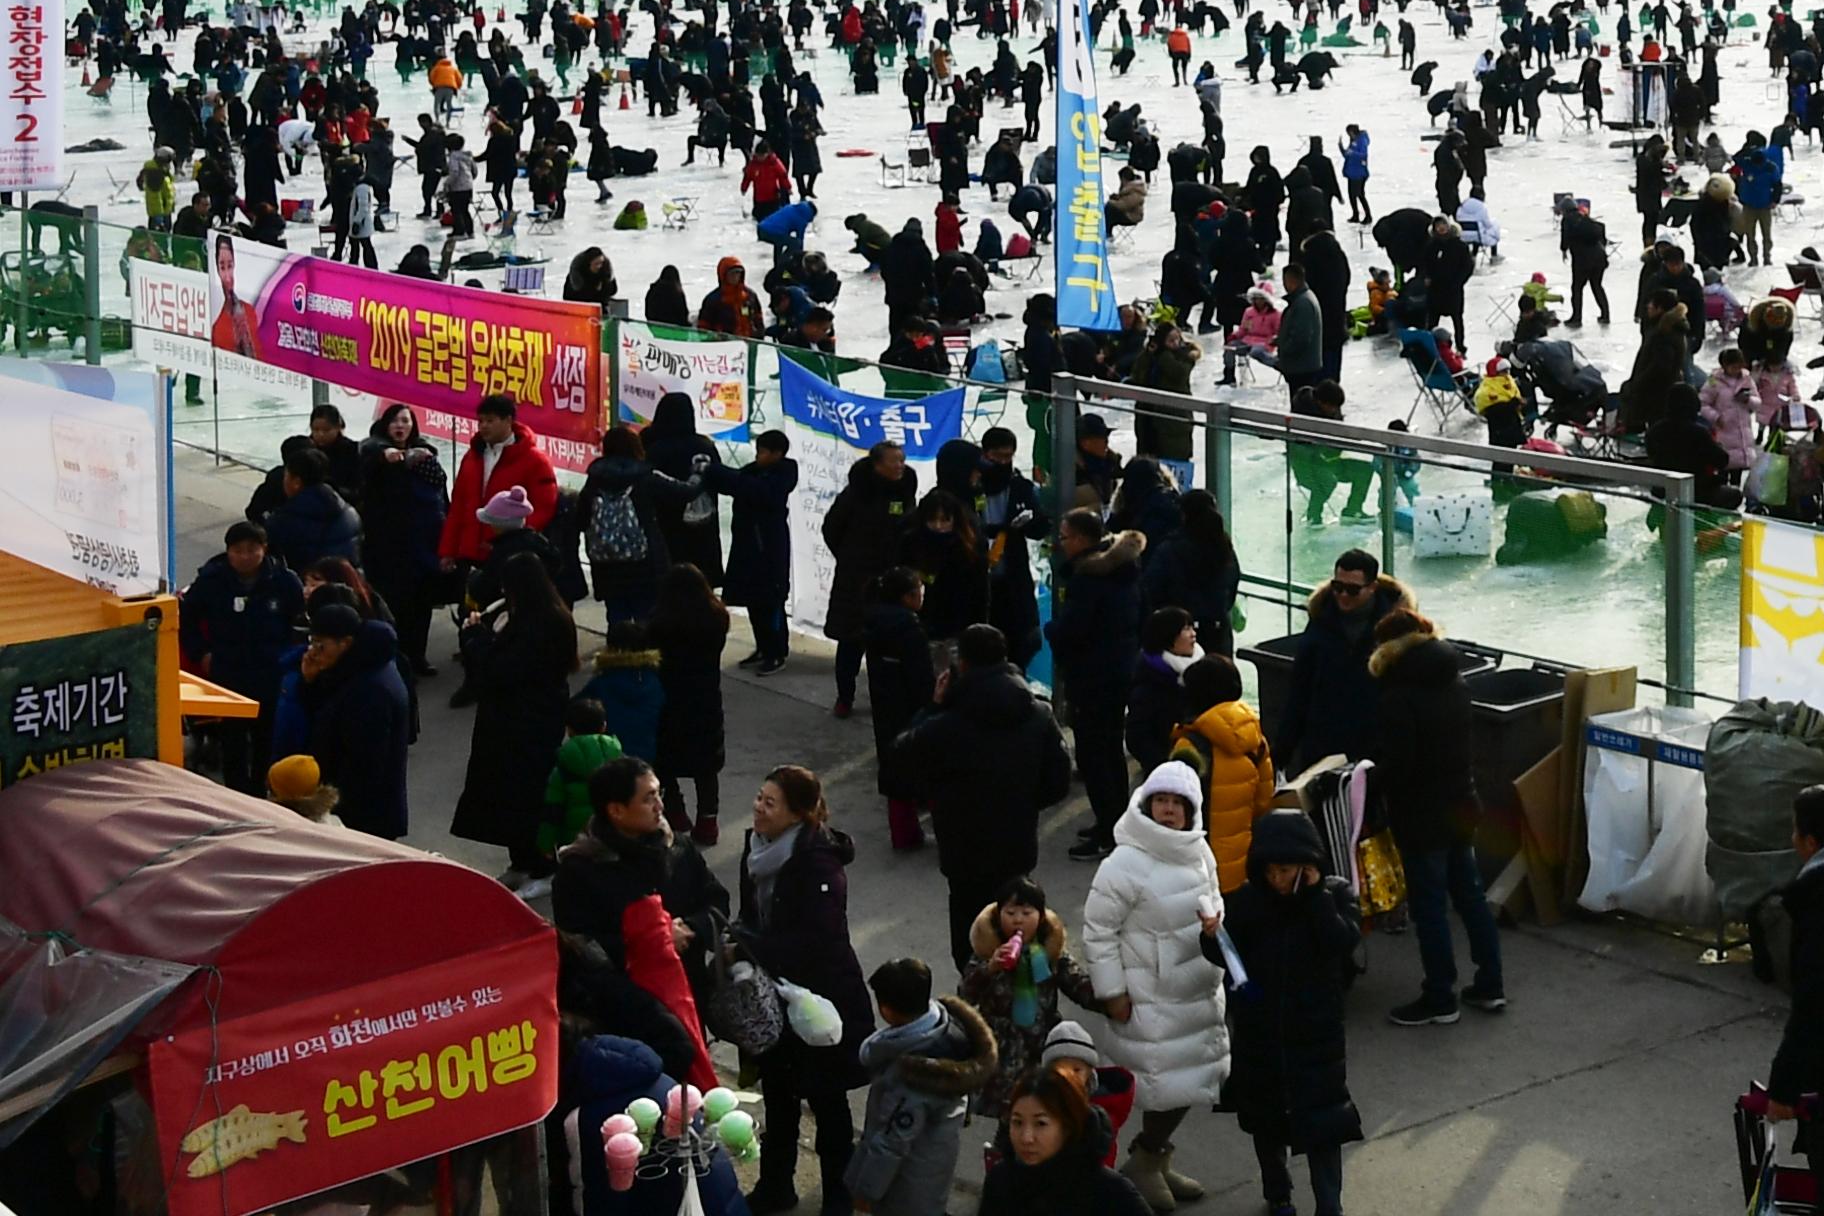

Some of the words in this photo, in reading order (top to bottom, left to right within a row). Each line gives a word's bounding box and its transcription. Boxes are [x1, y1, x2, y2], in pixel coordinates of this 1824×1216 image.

[8, 5, 48, 106] 현장접수
[14, 113, 39, 142] 2
[414, 309, 467, 392] 글로벌
[550, 344, 587, 414] 선정
[643, 342, 692, 380] 판매장
[13, 670, 128, 739] 축제기간
[205, 1047, 290, 1085] 지구상에서
[293, 1036, 328, 1059] 오직
[328, 1012, 419, 1050] 화천에서만
[421, 997, 468, 1027] 맛볼수
[471, 985, 504, 1009] 있는
[321, 1019, 538, 1139] 산천어빵
